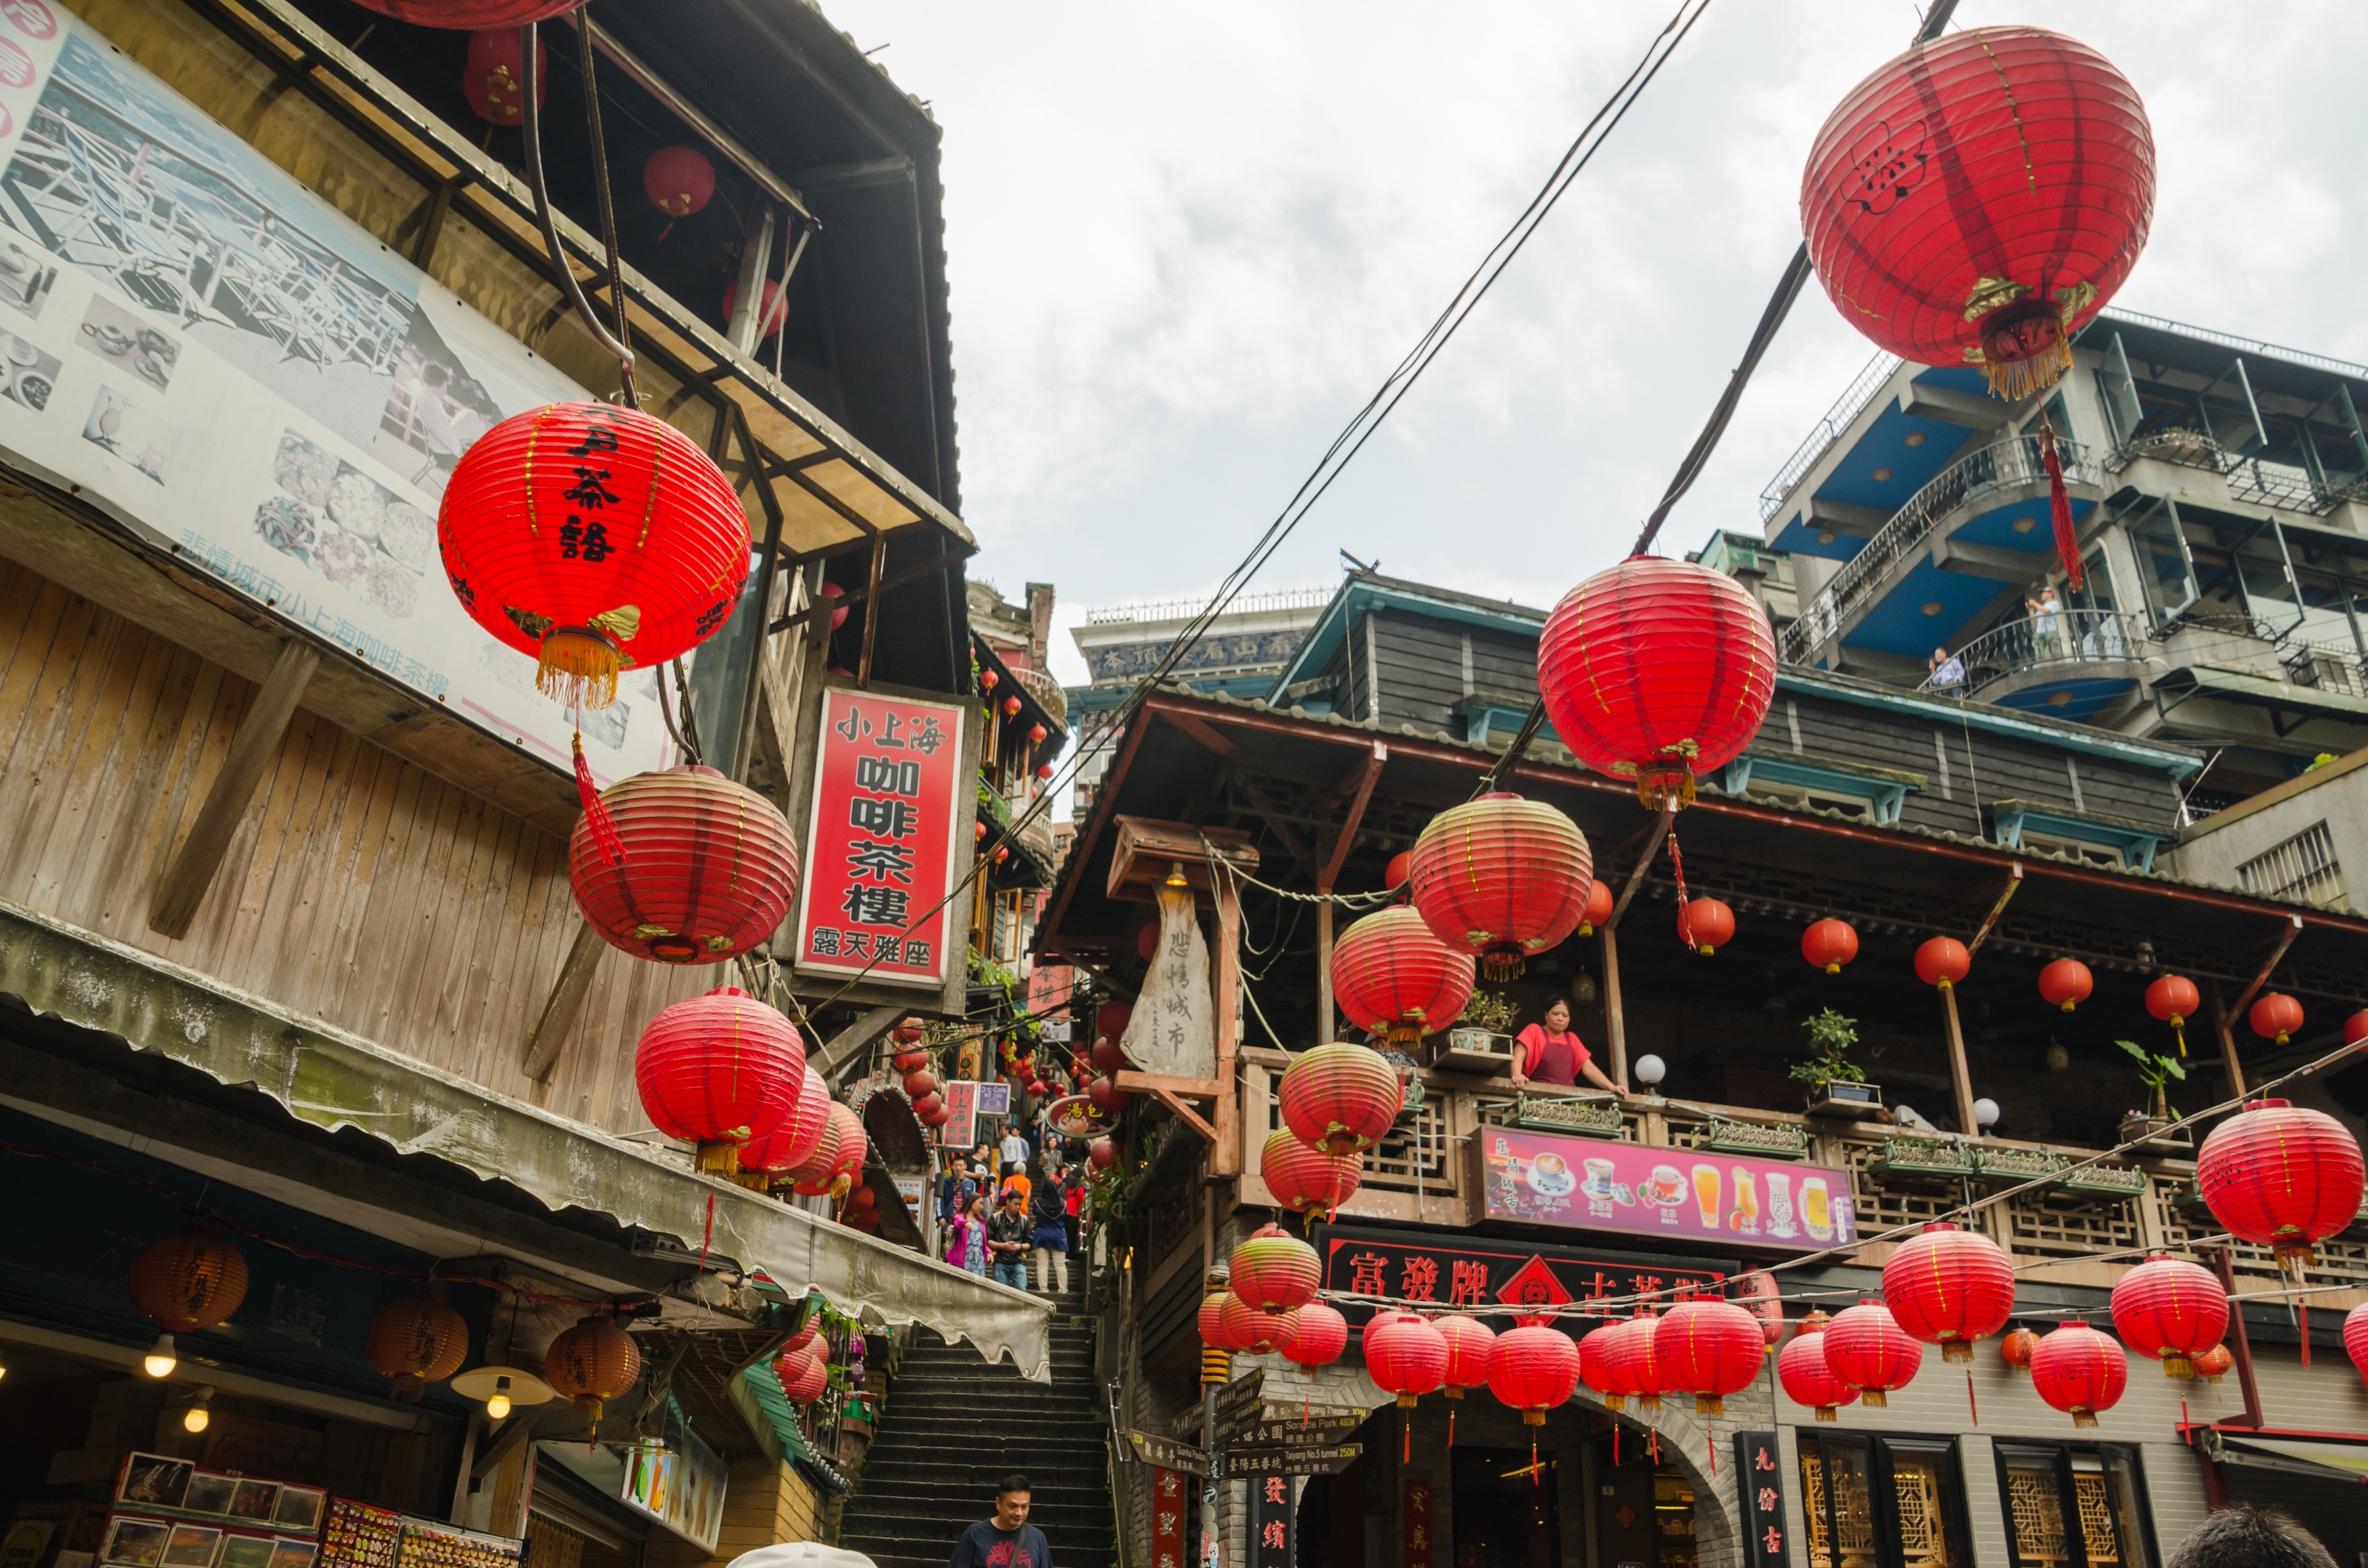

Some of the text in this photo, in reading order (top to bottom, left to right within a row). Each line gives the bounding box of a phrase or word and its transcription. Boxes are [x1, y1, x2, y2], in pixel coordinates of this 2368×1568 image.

[180, 528, 450, 696] 悲情城市小上海咖啡茶樓
[836, 706, 947, 755] 小上海
[842, 756, 921, 929] 咖啡茶樓
[811, 926, 931, 968] 露天雅座
[1167, 930, 1192, 1059] 悲情城市
[951, 1085, 970, 1123] 小上海
[1067, 1102, 1103, 1118] 湯包
[1495, 1138, 1519, 1212] 悲情城市
[1350, 1252, 1488, 1305] 富發牌
[1286, 1417, 1355, 1431] Songde Park 480M
[1327, 1406, 1349, 1415] Theater
[1352, 1409, 1366, 1417] 10M
[1285, 1448, 1356, 1462] Taiyang No.5 tunnel 250M
[1755, 1447, 1782, 1553] 九份古
